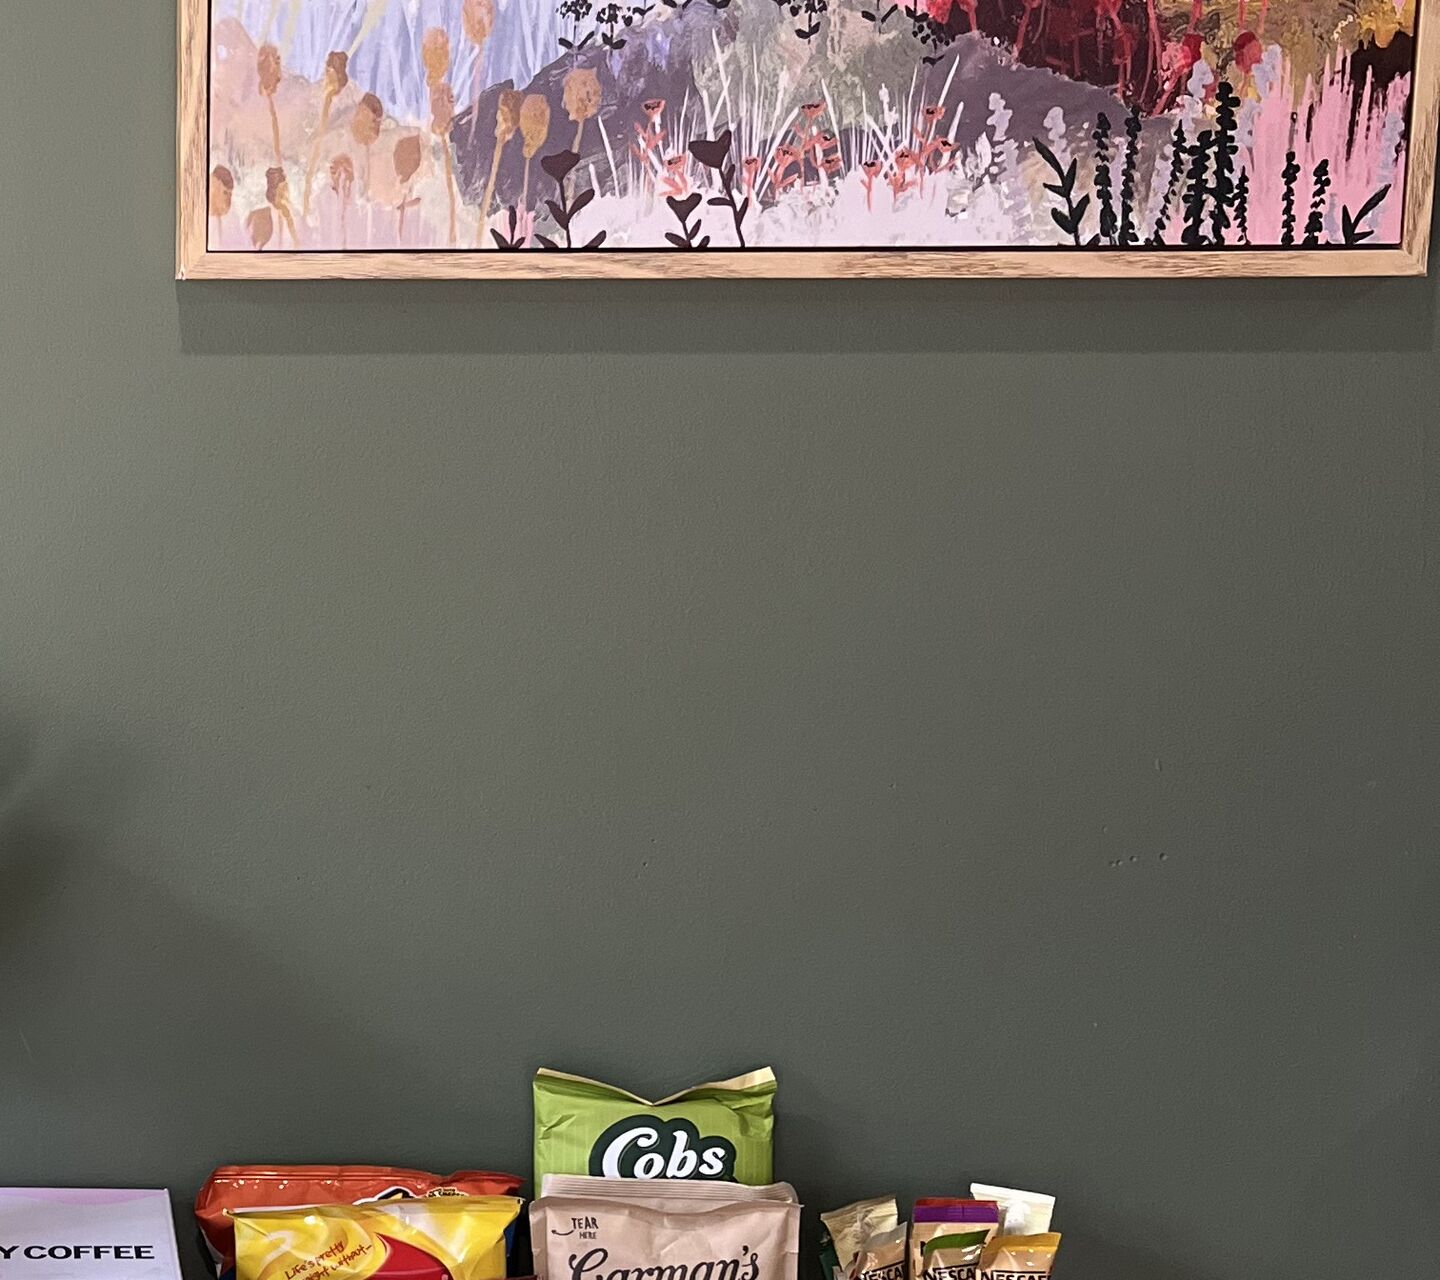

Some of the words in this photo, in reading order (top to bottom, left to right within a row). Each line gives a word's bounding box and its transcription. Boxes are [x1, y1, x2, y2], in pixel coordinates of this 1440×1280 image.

[602, 1127, 727, 1180] Cobs
[571, 1216, 599, 1230] TEAR
[579, 1231, 597, 1240] HERE
[23, 1244, 155, 1260] COFFEE
[285, 1257, 315, 1280] Life's
[315, 1240, 345, 1266] pretty
